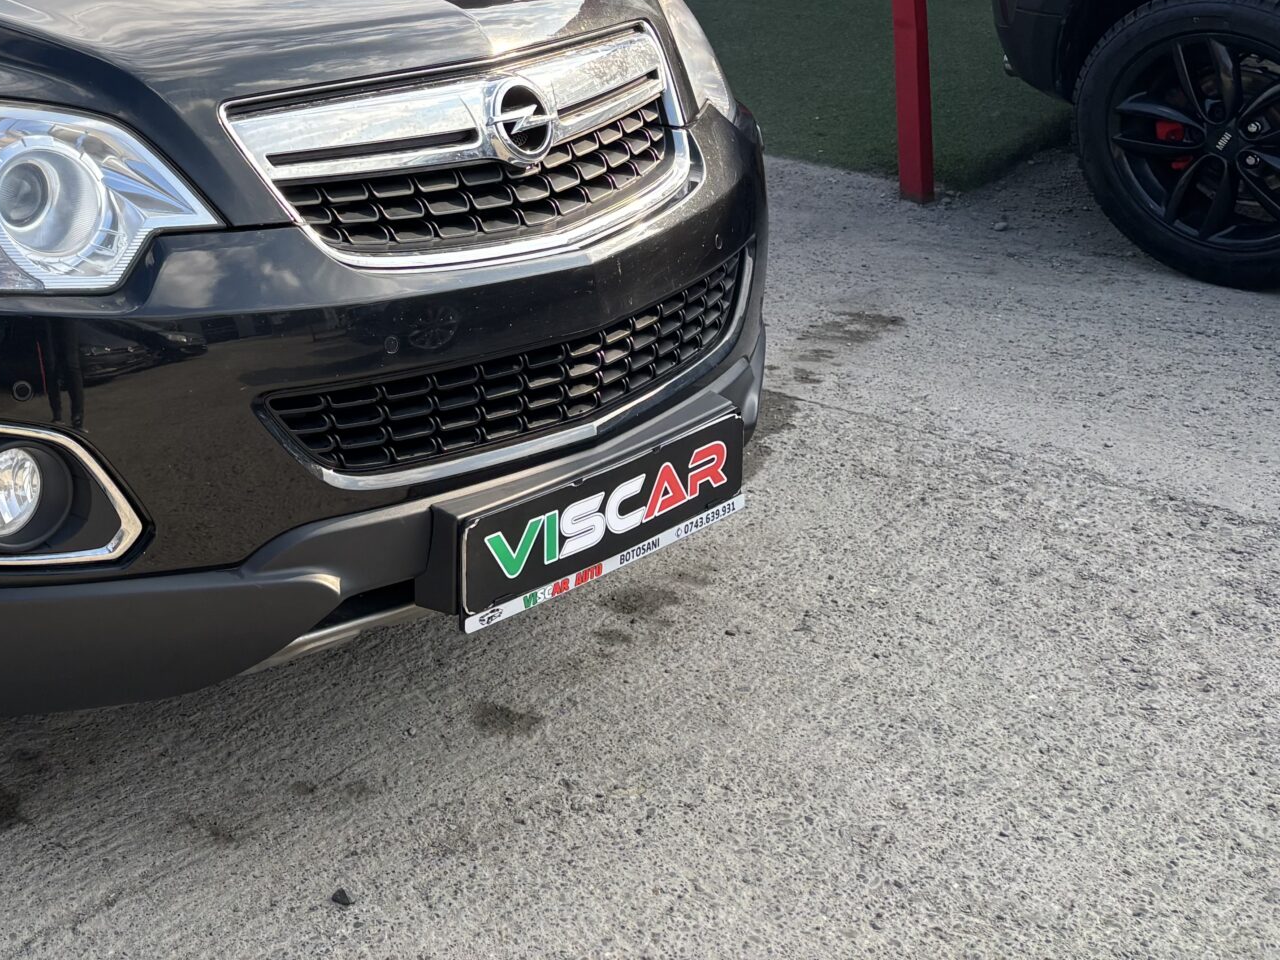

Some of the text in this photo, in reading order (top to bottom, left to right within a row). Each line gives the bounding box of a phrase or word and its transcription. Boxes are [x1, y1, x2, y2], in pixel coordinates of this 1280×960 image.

[1215, 132, 1232, 151] MINI
[484, 440, 727, 579] VISCAR
[523, 501, 736, 609] VISCAR AUTO BOTOSANI 0743.639.931
